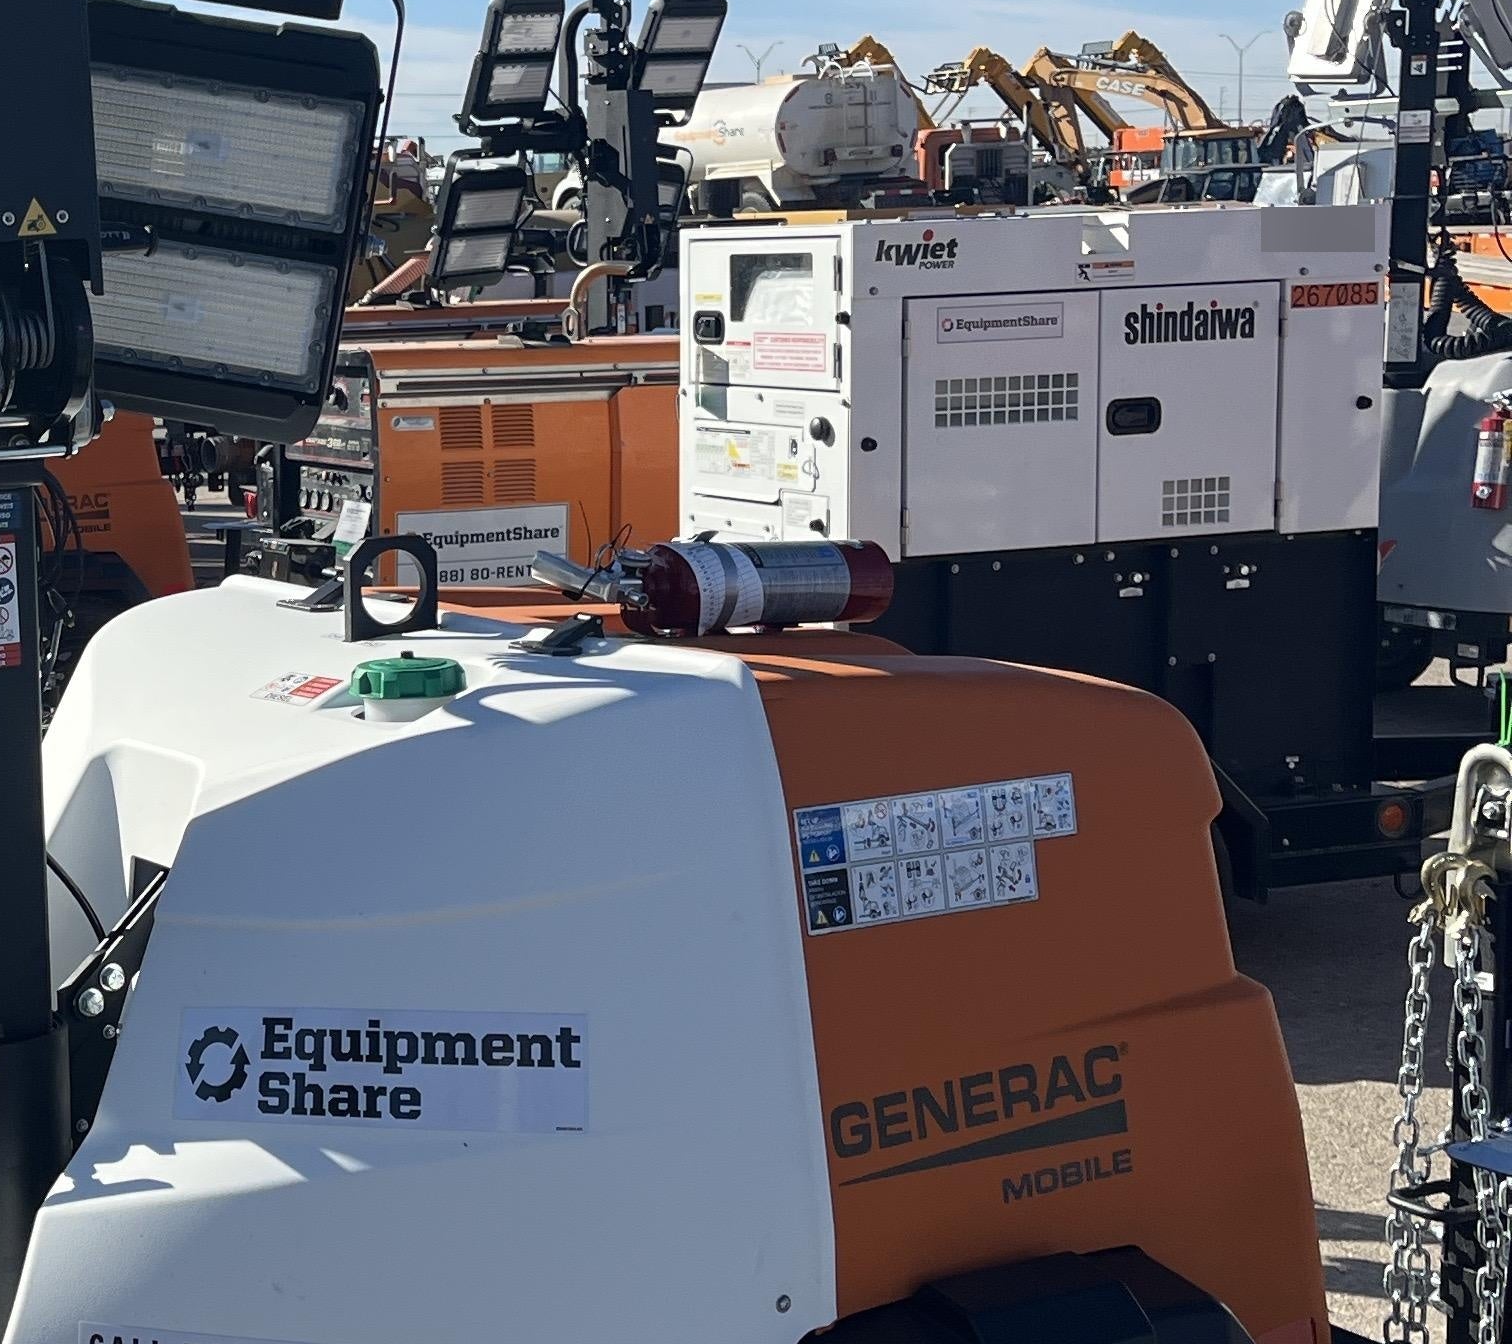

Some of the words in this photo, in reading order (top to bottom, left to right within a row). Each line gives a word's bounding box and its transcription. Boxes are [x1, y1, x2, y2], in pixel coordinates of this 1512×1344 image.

[1095, 76, 1146, 96] CASE
[919, 259, 956, 270] POWER
[1292, 283, 1379, 308] 267085
[955, 314, 1059, 332] EquipmentShare
[1124, 300, 1256, 345] shindaiwa
[423, 523, 561, 548] EquipmentShare
[470, 564, 532, 580] 80-RENT
[260, 1017, 581, 1074] Equipment
[257, 1071, 422, 1121] Share
[831, 1044, 1123, 1159] GENERAC
[1001, 1149, 1134, 1205] MOBILE
